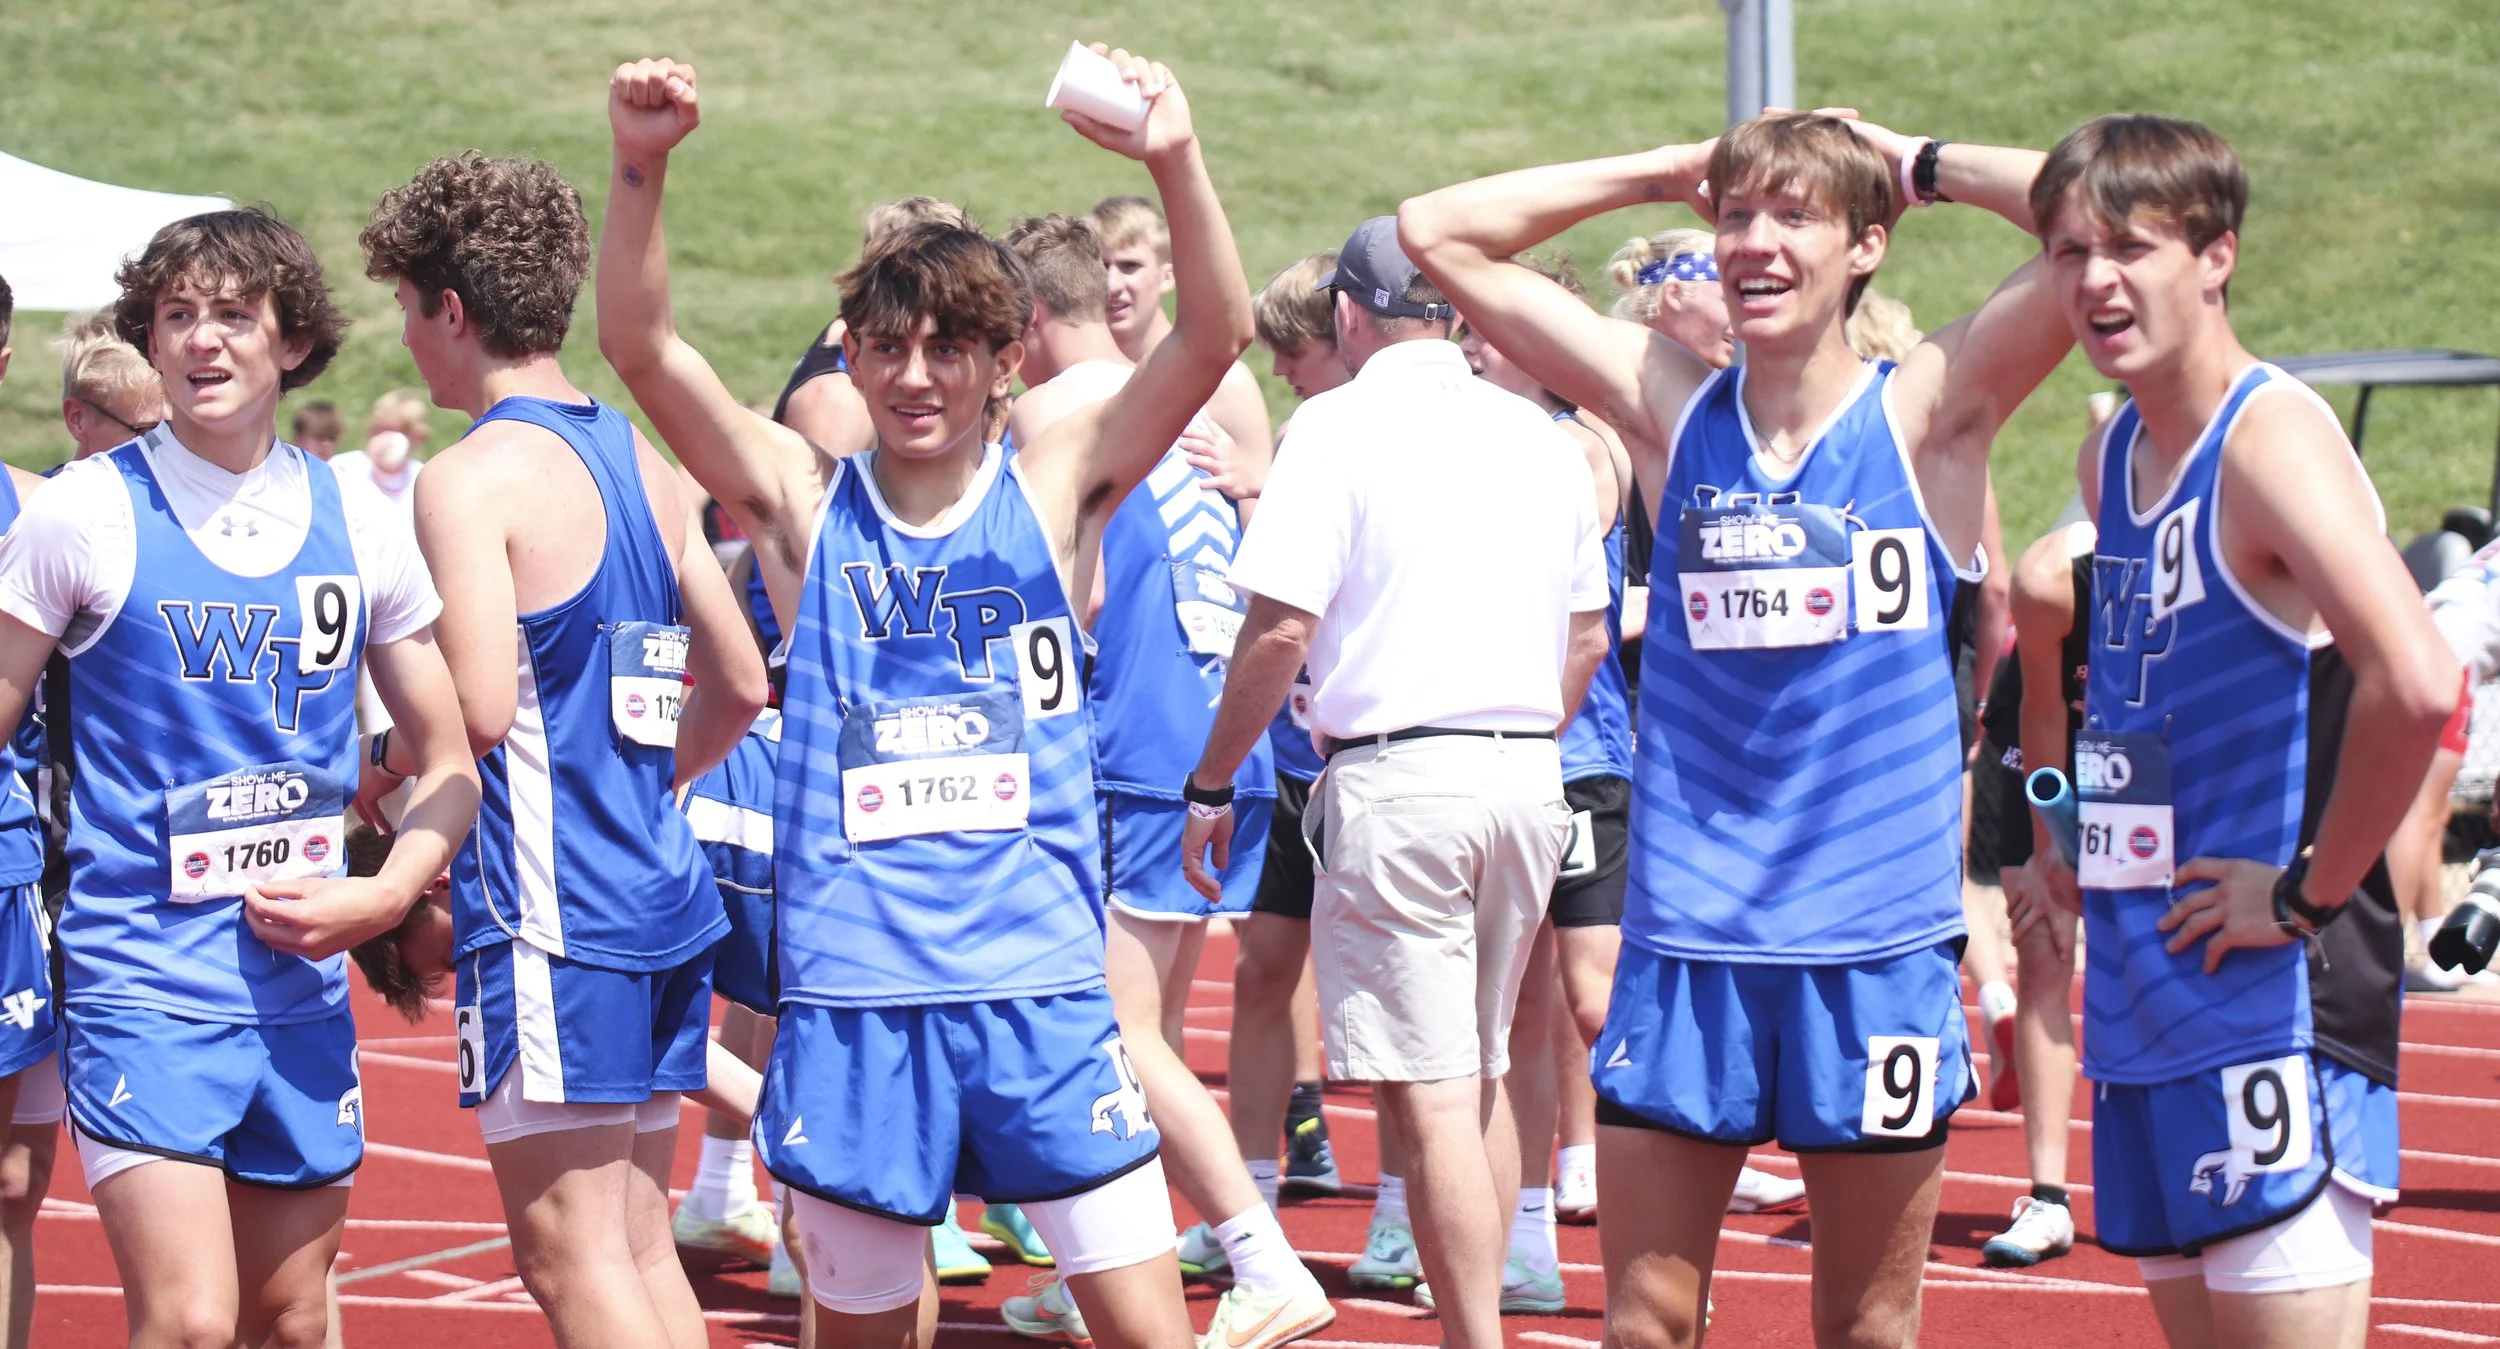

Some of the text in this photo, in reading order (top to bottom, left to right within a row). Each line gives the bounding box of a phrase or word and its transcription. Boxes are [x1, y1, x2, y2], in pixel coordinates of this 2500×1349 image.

[1720, 513, 1780, 527] SHOW-ME
[1699, 523, 1807, 561] ZERO
[2163, 513, 2184, 607] 9
[1869, 537, 1911, 625] 9
[841, 561, 1027, 683] WP
[1720, 588, 1789, 619] 1764
[313, 582, 348, 666] 9
[643, 638, 689, 671] ZER
[1029, 625, 1064, 711] 9
[900, 703, 962, 718] SHOW-ME
[874, 711, 990, 753] ZERO
[231, 770, 287, 786] SHOW-ME
[898, 775, 978, 806] 1762
[2075, 752, 2133, 791] ERO
[206, 778, 309, 820] ZERO
[224, 837, 290, 873] 1760
[2078, 822, 2112, 856] 761
[459, 1010, 475, 1088] 6
[1881, 1044, 1921, 1130] 9
[2243, 1066, 2290, 1166] 9
